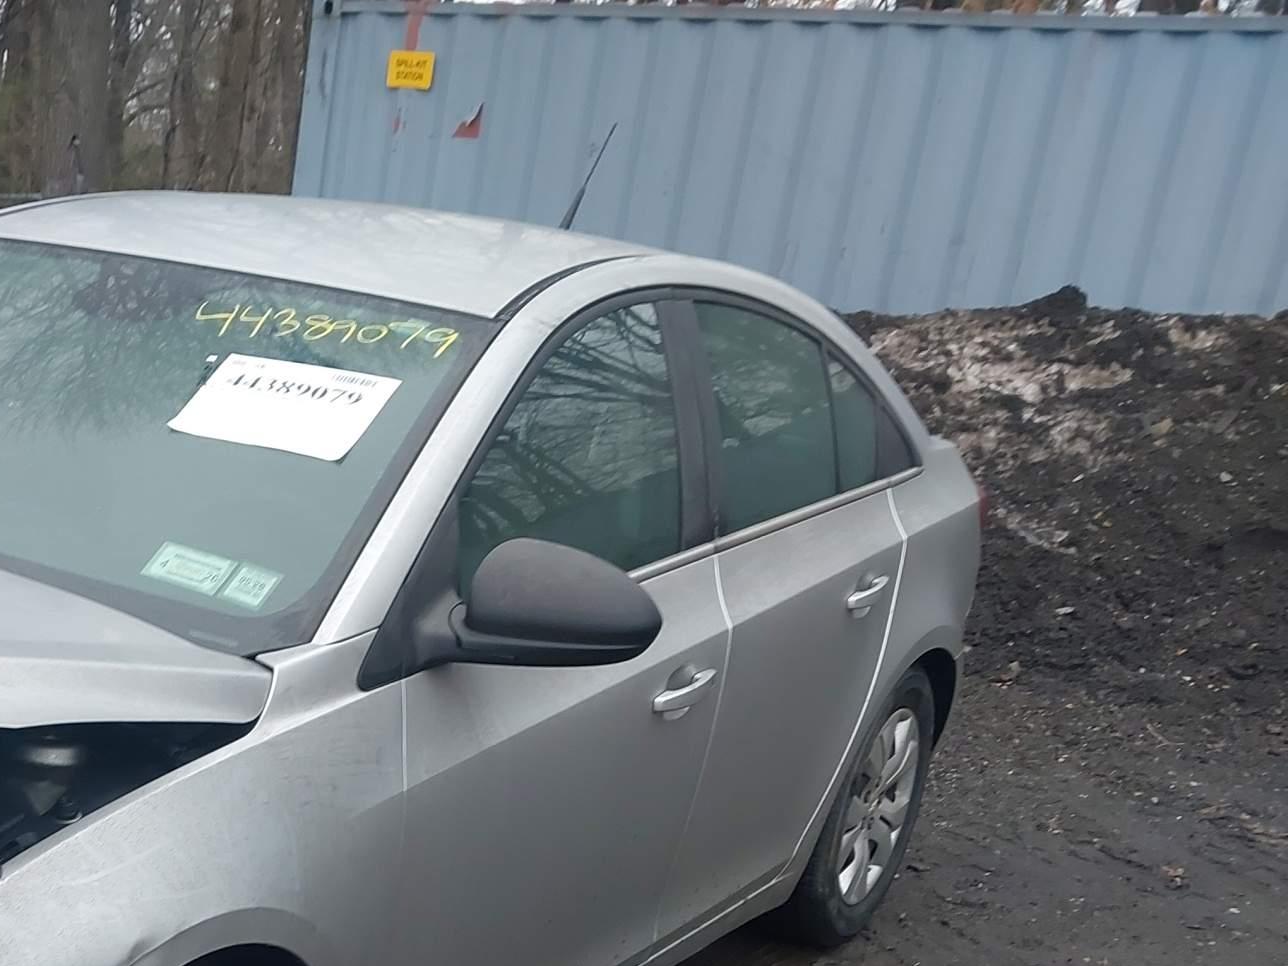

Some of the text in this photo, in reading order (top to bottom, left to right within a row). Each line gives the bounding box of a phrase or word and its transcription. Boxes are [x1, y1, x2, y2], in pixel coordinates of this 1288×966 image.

[395, 71, 424, 81] STATION
[195, 301, 460, 359] 44389079
[227, 373, 363, 405] 44389079
